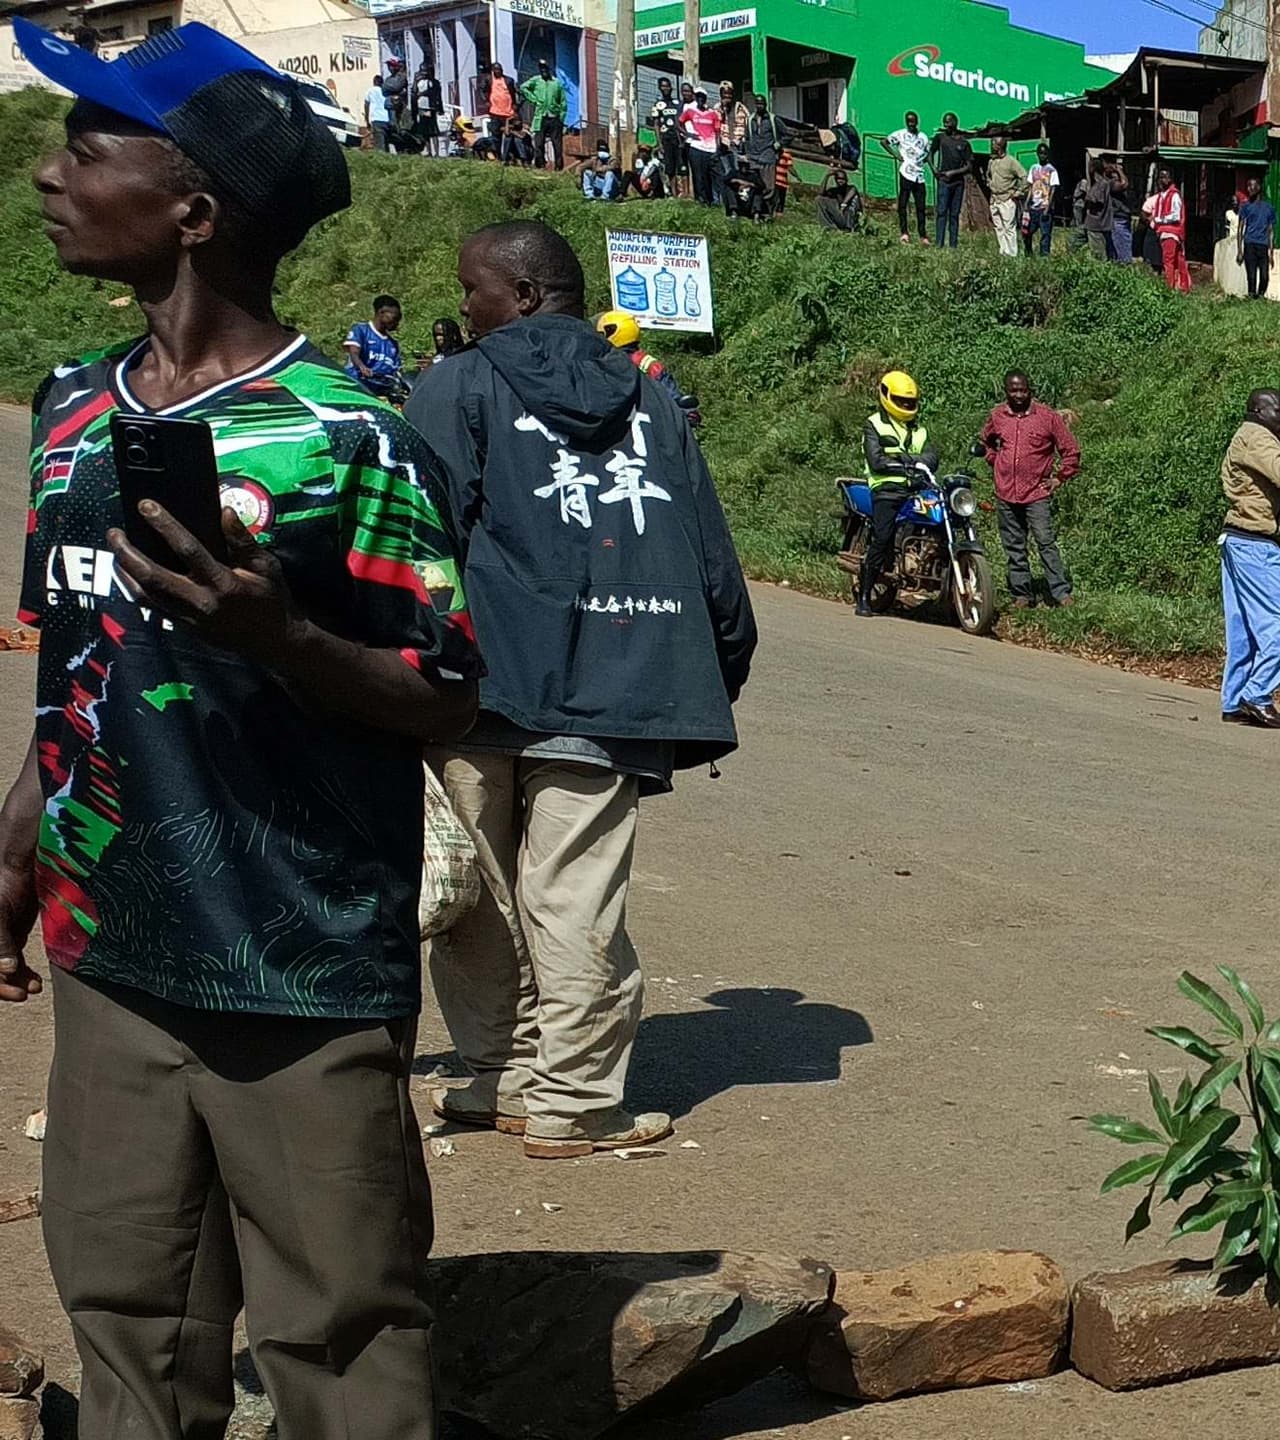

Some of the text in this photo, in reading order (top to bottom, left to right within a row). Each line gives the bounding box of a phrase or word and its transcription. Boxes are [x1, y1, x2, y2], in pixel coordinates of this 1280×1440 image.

[913, 53, 1030, 102] Safaricom
[656, 234, 702, 248] PURIFIED
[609, 242, 697, 258] DRINKING WATER
[610, 252, 701, 269] REFILLING STATION
[533, 448, 673, 536] 青年
